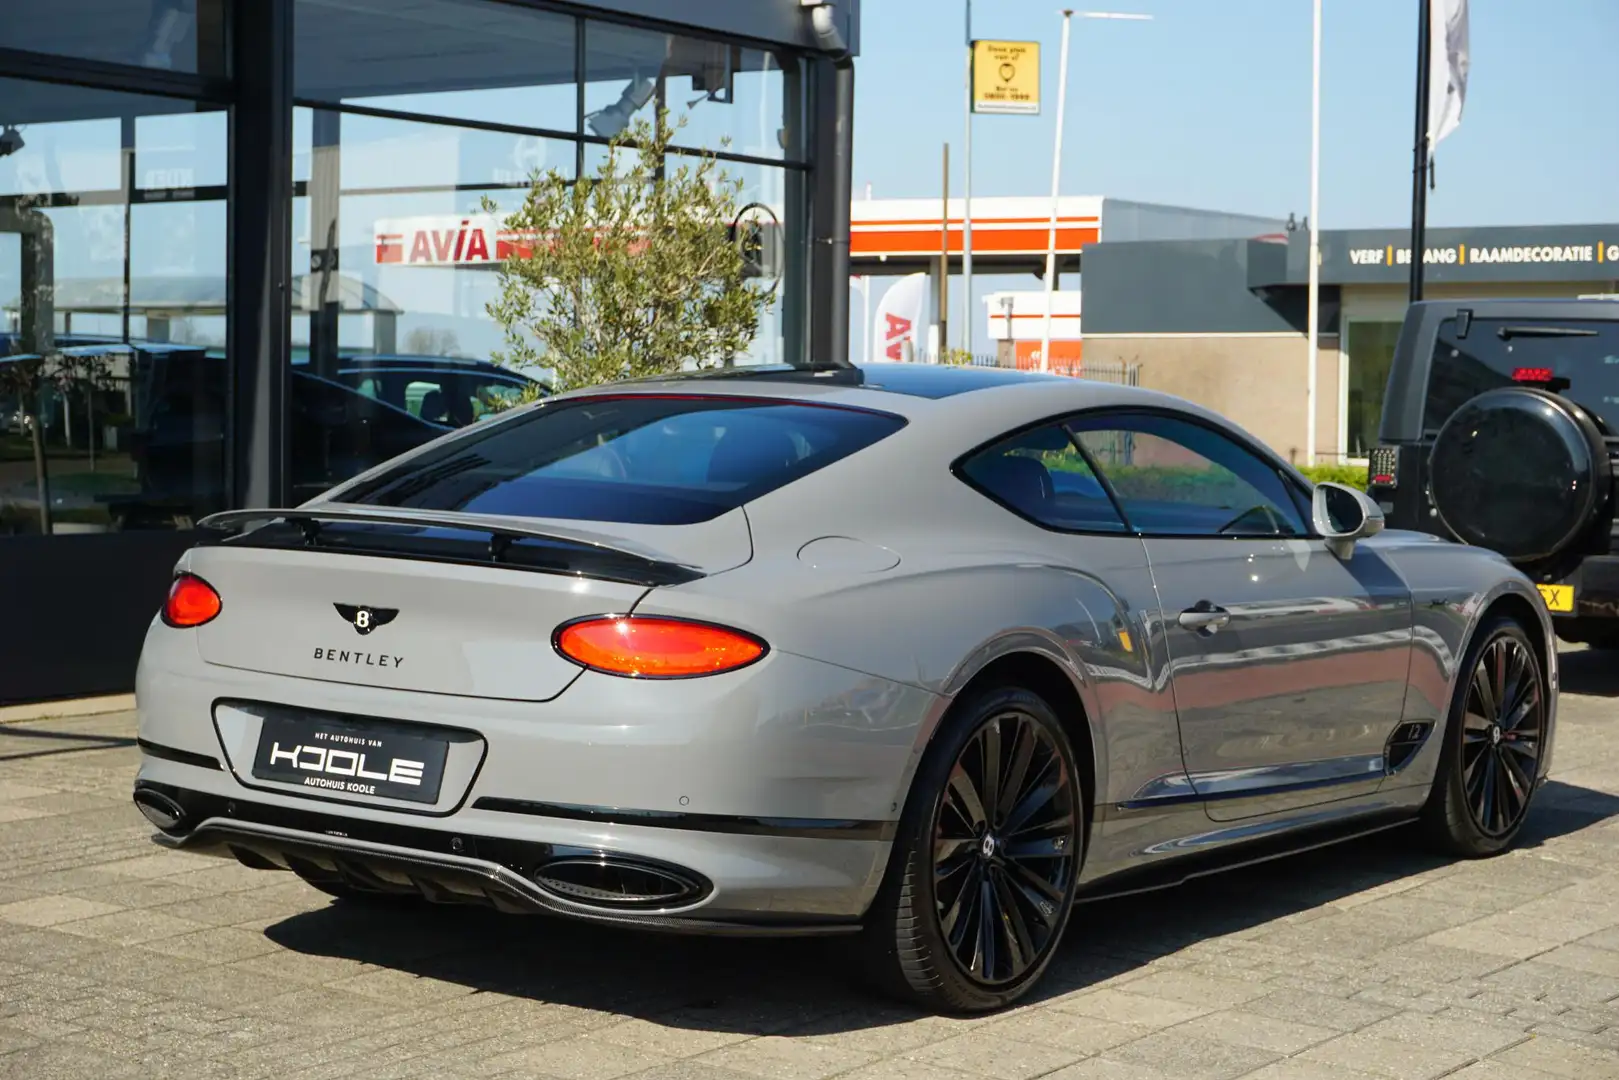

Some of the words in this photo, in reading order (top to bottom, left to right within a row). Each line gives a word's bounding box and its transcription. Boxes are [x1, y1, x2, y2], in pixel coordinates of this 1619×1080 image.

[1350, 249, 1384, 265] VERF
[1396, 248, 1457, 264] BEANG
[1469, 246, 1593, 264] RAAMDECORATIE
[313, 647, 404, 669] BENTLEY
[314, 732, 328, 742] HET
[330, 734, 366, 746] AUTOHUIS
[368, 738, 383, 748] VAN
[303, 776, 345, 791] AUTOHUIS
[346, 782, 376, 795] KOOLE
